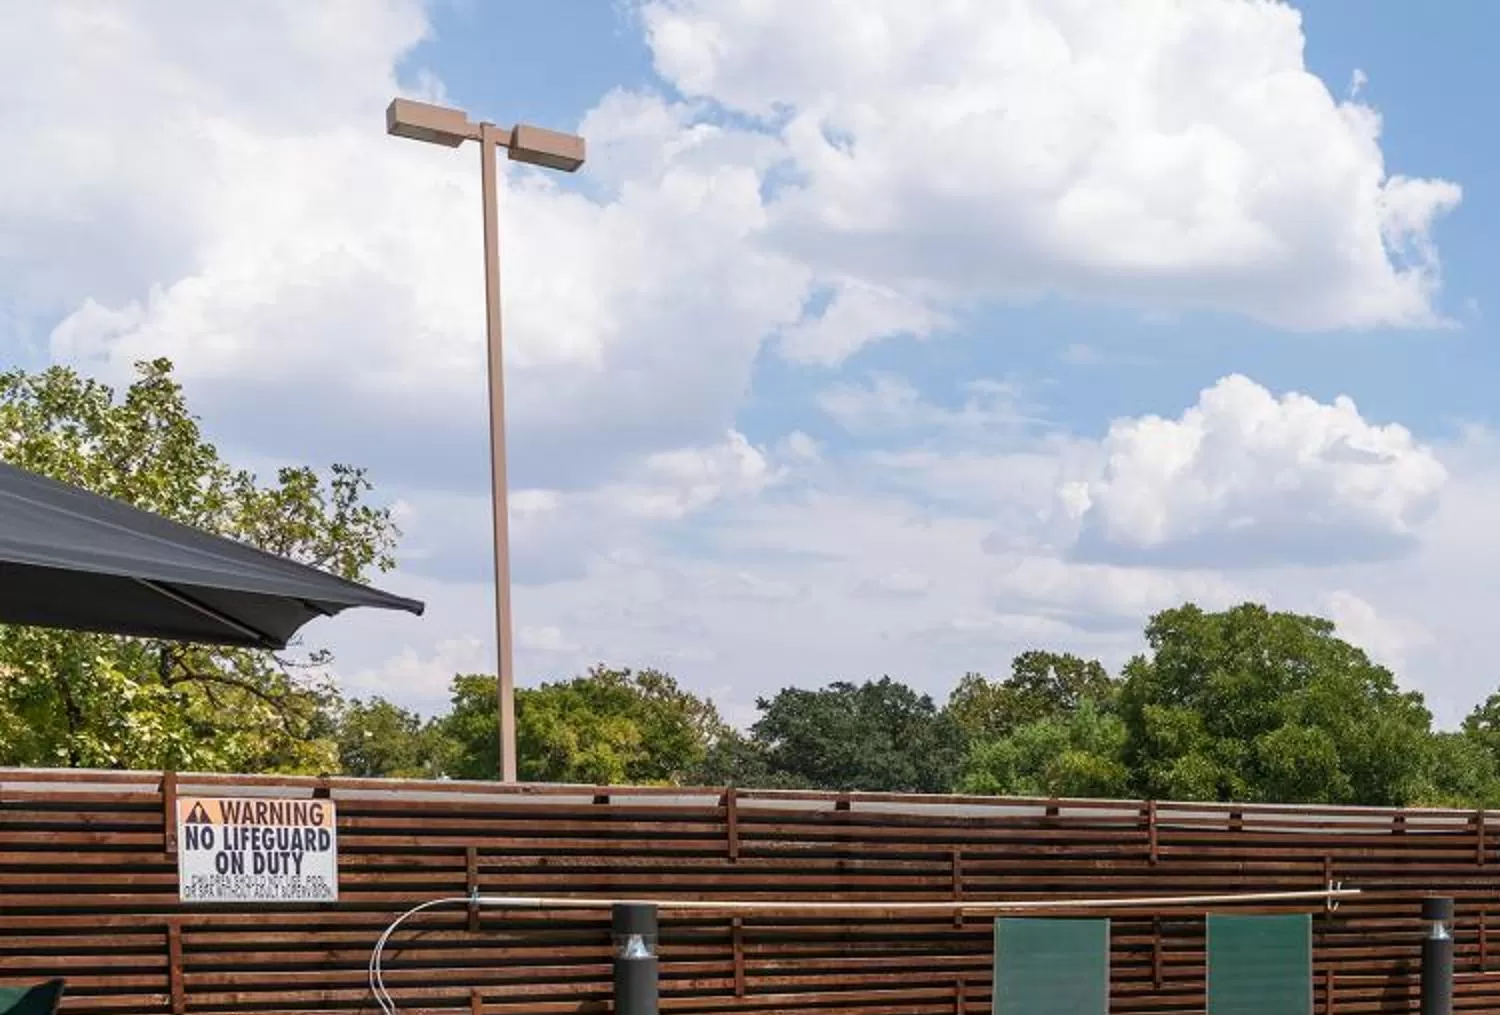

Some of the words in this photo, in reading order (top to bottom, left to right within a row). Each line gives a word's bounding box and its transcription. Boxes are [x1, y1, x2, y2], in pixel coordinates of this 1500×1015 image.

[219, 800, 324, 826] WARNING
[185, 826, 214, 850] NO
[223, 827, 331, 851] LIFEGUARD
[215, 851, 245, 875] ON
[253, 851, 304, 876] DUTY
